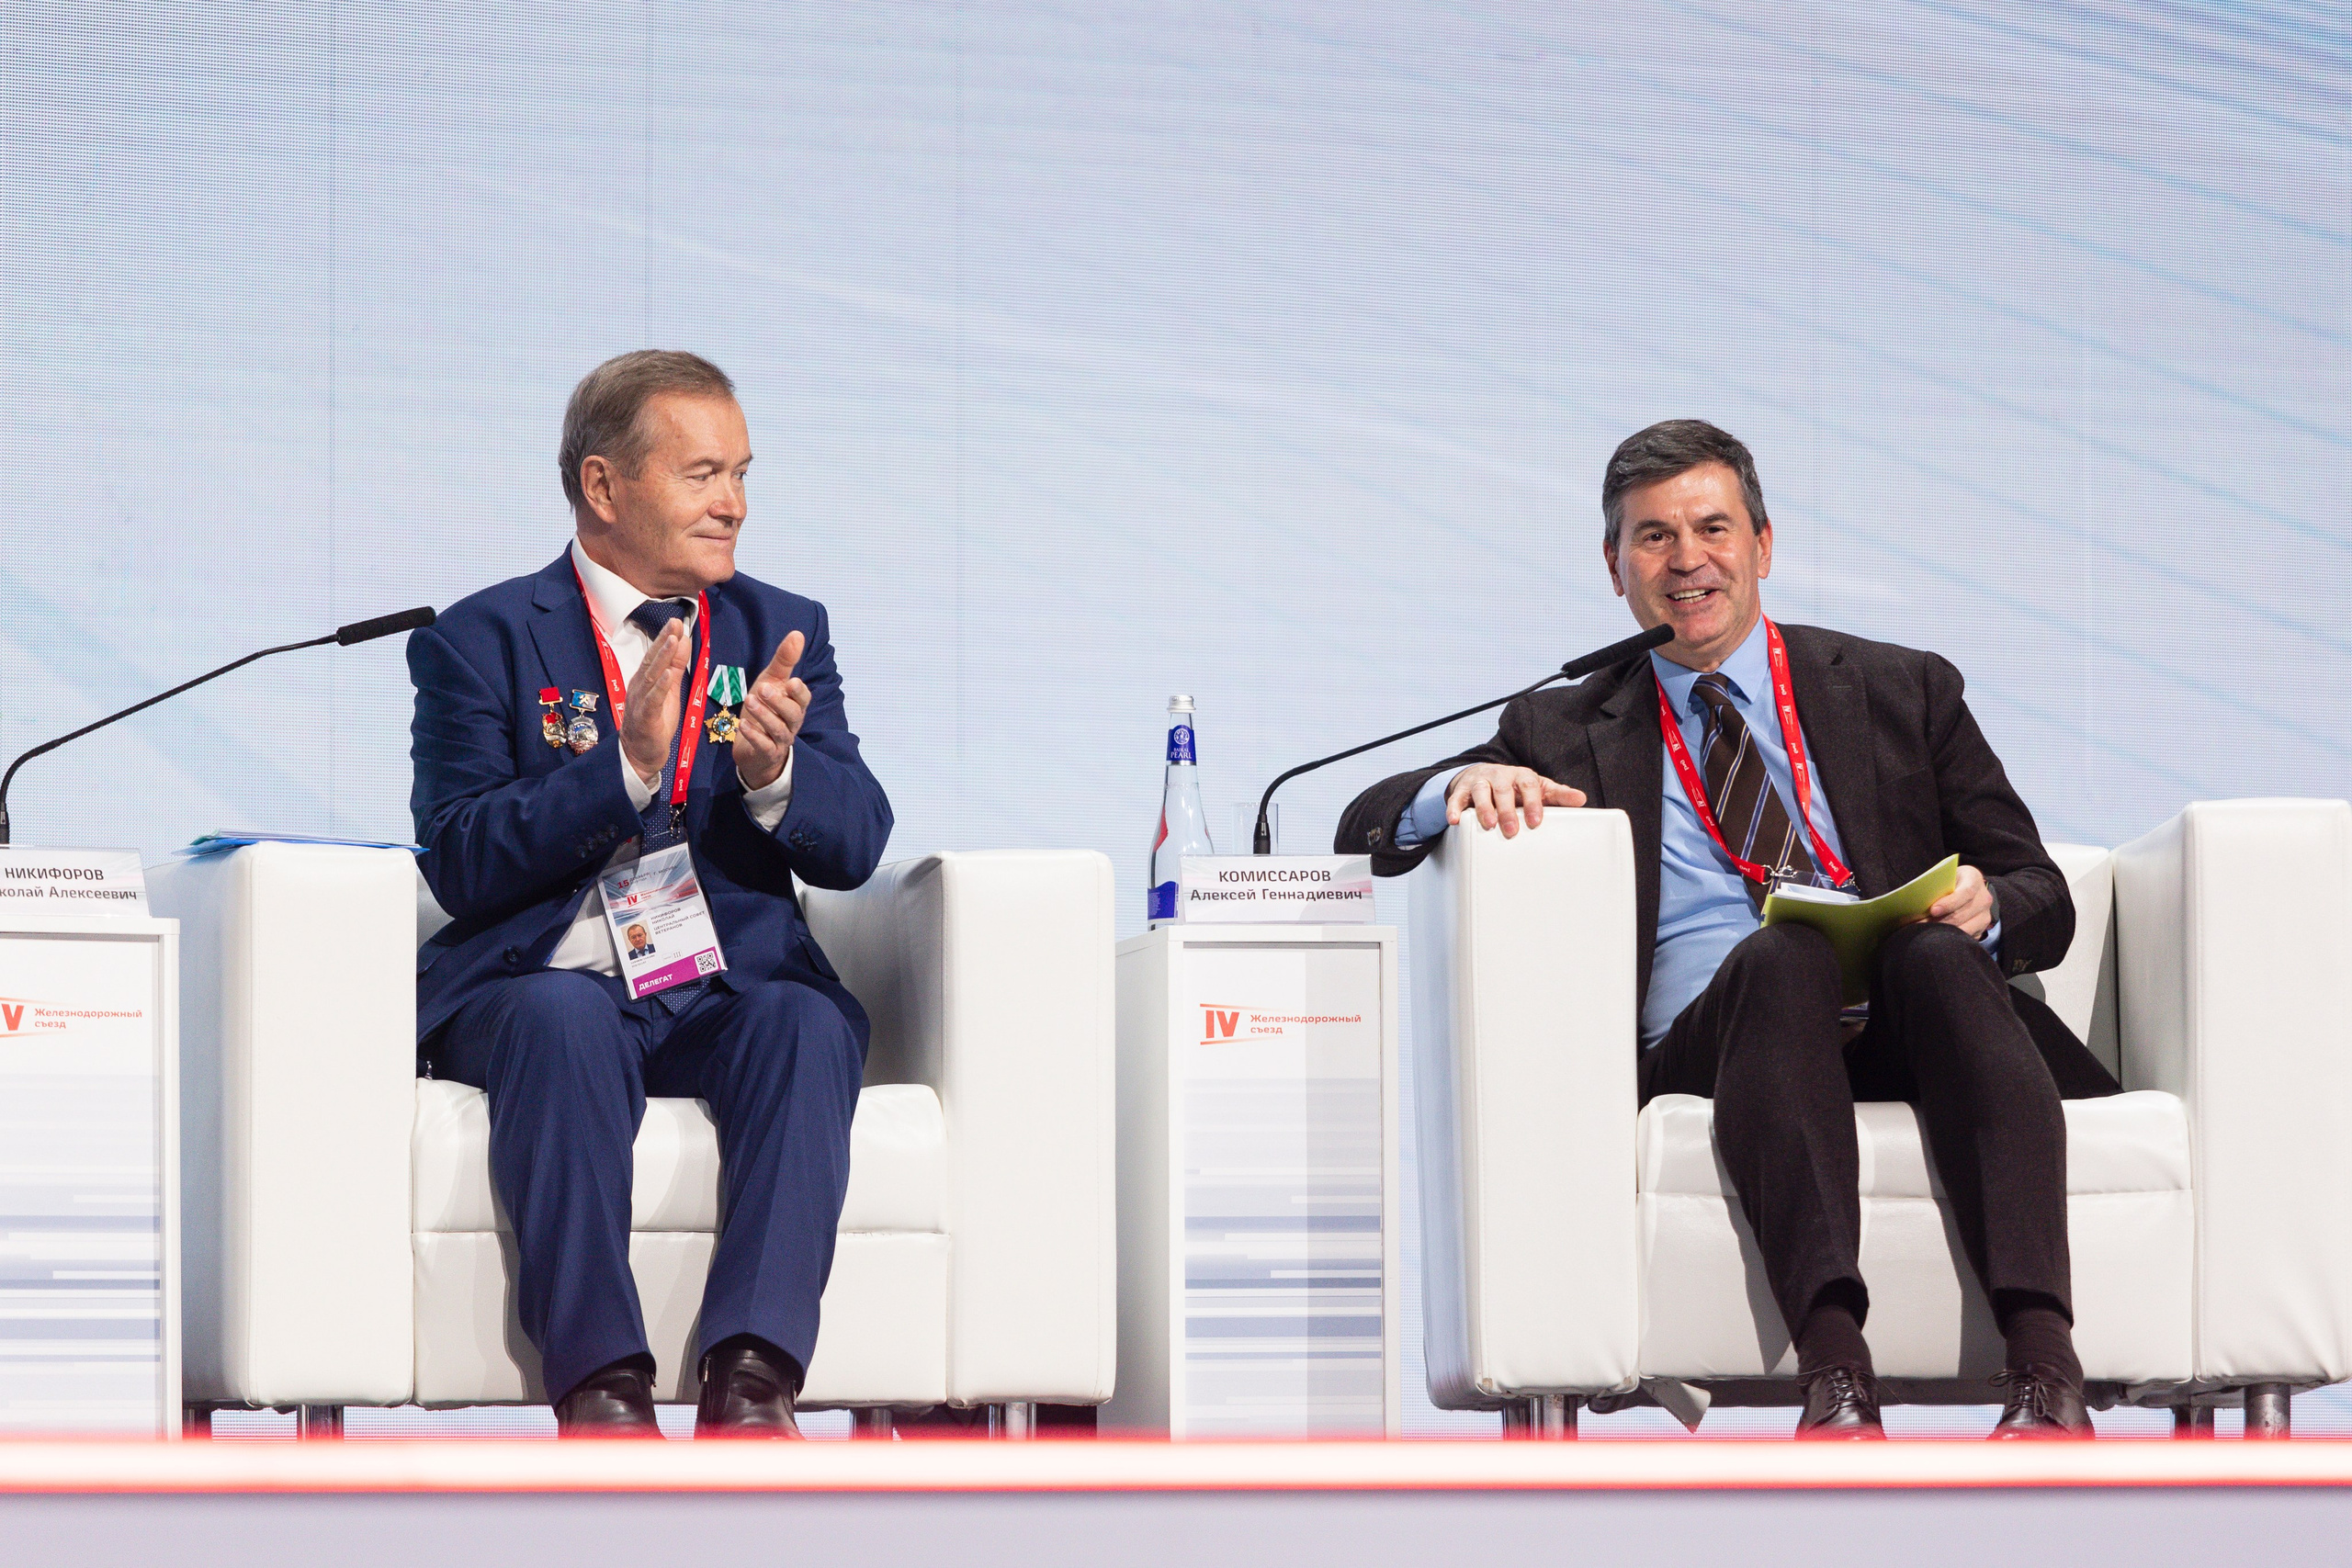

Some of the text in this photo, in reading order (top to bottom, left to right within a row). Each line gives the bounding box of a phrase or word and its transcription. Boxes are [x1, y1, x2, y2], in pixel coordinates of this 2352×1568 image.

[1170, 751, 1193, 760] PEARL
[5, 867, 105, 881] НИКИФОРОВ
[1218, 870, 1331, 882] КОМИССАРОВ
[617, 879, 629, 889] 15
[0, 886, 138, 900] колай Алексеевич
[1190, 887, 1363, 903] Алексей Геннадиевич
[627, 895, 638, 905] IV
[651, 914, 675, 924] НИКОЛАЙ
[653, 910, 705, 931] ЦЕНТРАЛЬНЫЙ СОВЕТ
[655, 923, 683, 935] ВЕТЕРАНОВ
[639, 974, 673, 991] ДЕЛЕГАТ
[1, 1003, 25, 1032] V
[34, 1008, 142, 1020] Железнодорожный
[1250, 1013, 1362, 1024] Железнодорожный
[34, 1020, 66, 1029] съезд
[1205, 1010, 1239, 1039] IV
[1250, 1026, 1283, 1034] съезд
